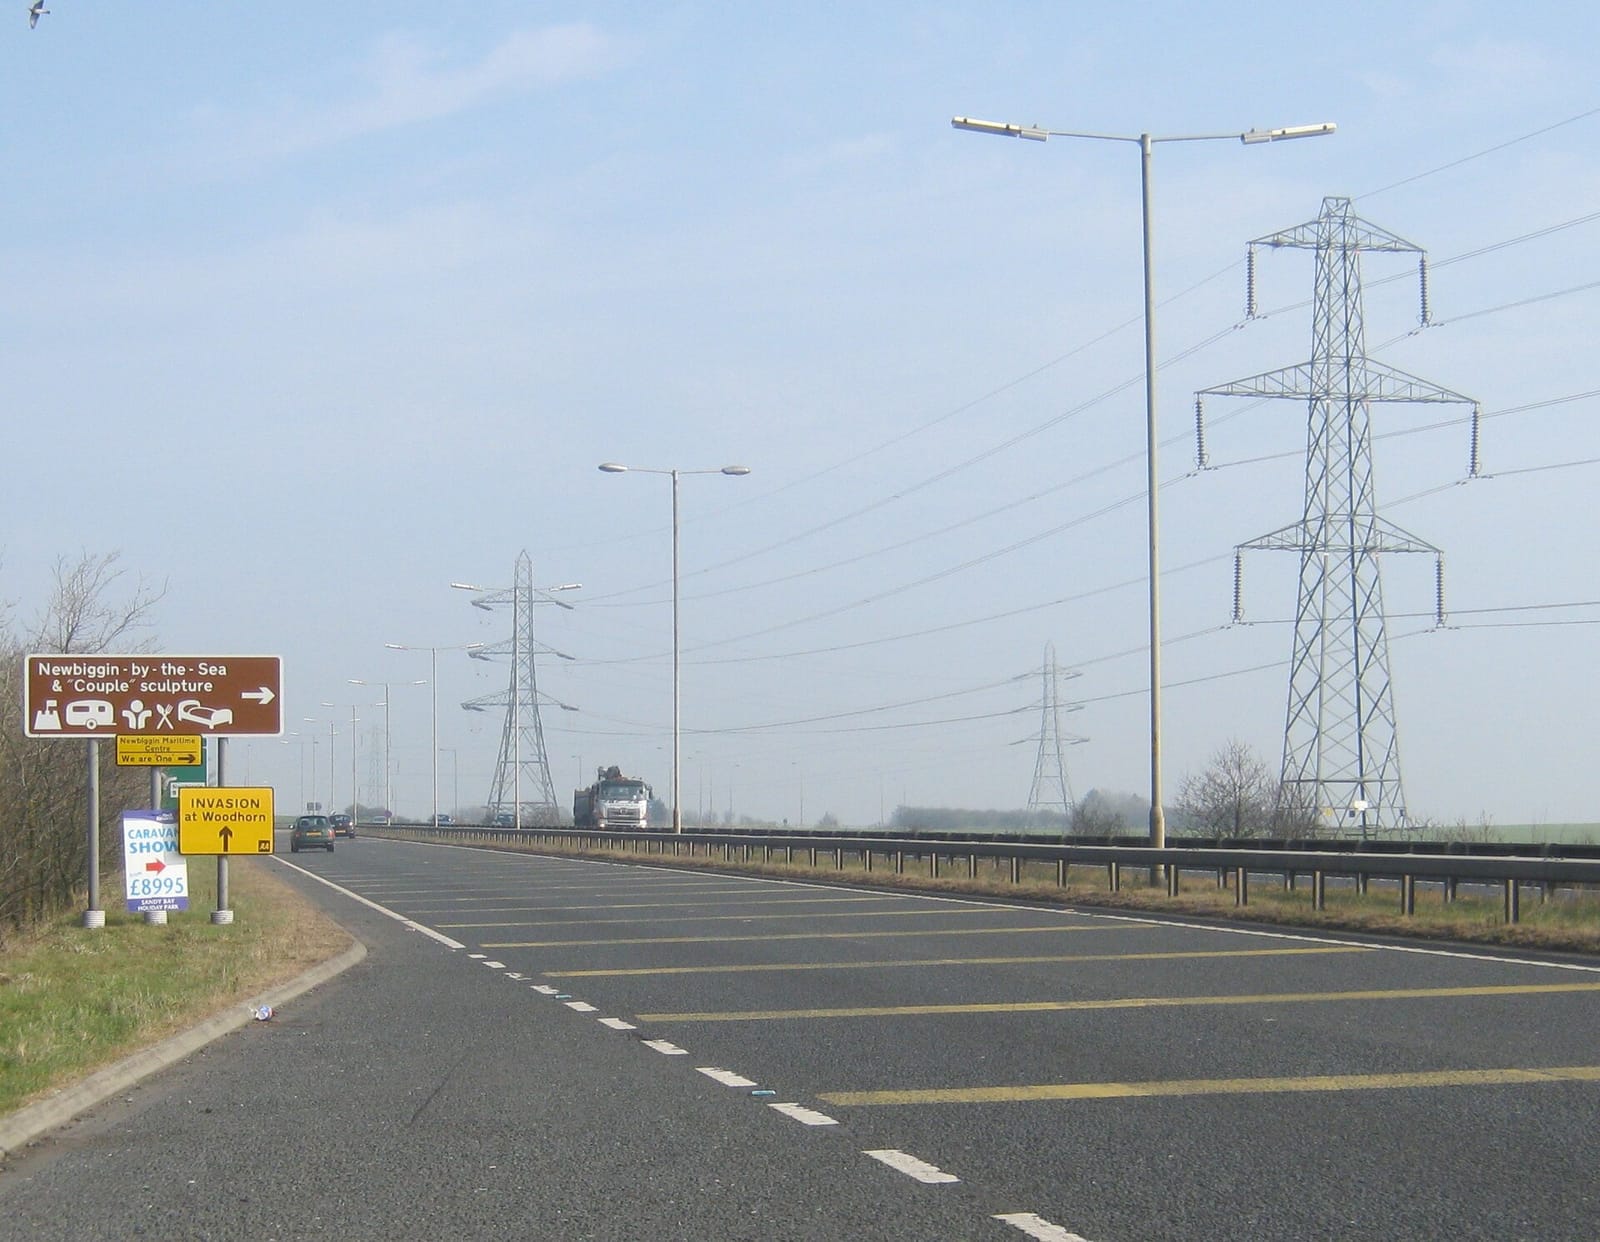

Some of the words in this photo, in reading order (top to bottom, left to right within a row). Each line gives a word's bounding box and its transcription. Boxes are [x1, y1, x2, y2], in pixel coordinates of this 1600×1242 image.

[51, 679, 62, 692] &
[140, 679, 213, 693] sculpture
[120, 737, 160, 745] Newbiggin
[162, 737, 195, 745] Maritime
[144, 745, 171, 753] Centre
[121, 755, 134, 763] We
[191, 798, 260, 809] INVASION
[184, 813, 197, 822] at
[202, 812, 266, 822] Woodhorn
[130, 877, 184, 896] £8995
